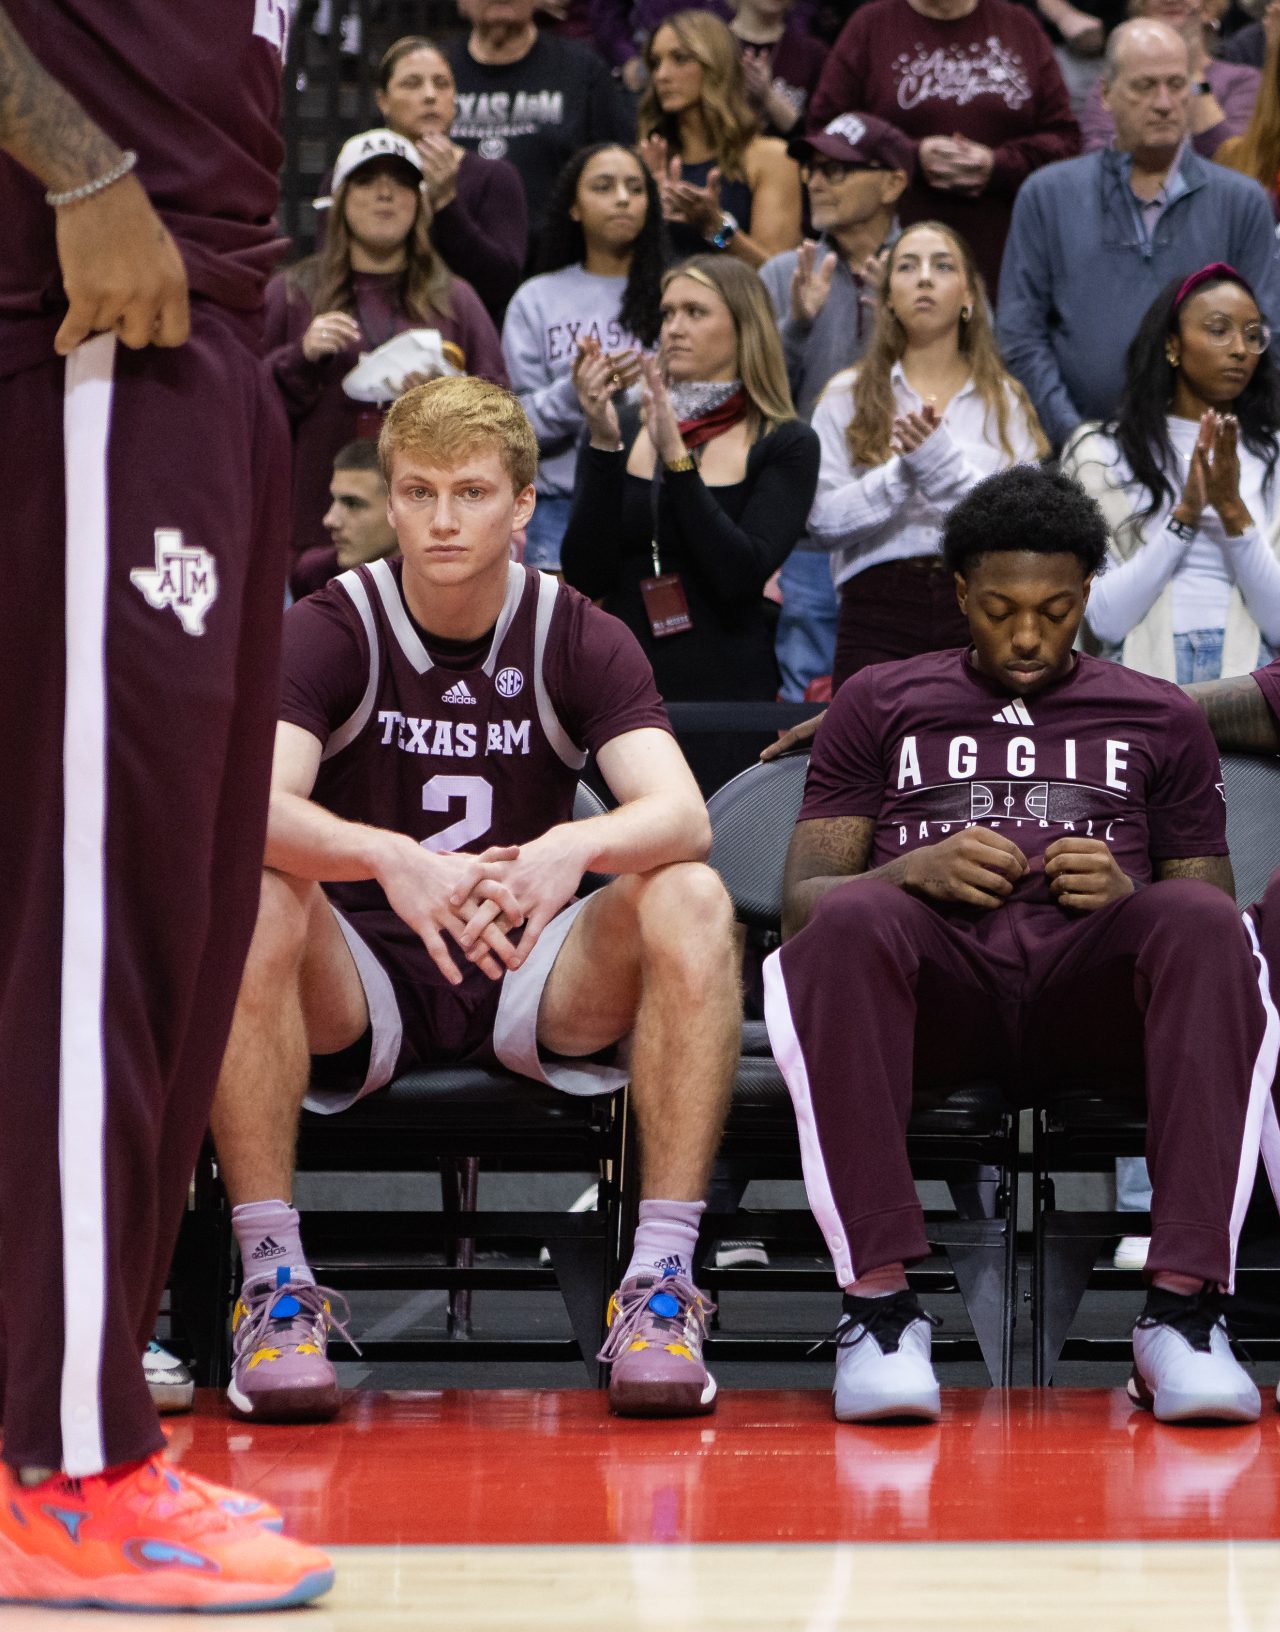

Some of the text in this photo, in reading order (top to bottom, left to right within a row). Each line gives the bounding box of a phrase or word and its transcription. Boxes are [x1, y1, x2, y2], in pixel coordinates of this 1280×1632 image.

[547, 320, 621, 361] EXAS
[441, 694, 477, 705] adidas
[498, 670, 521, 695] SEC
[484, 719, 531, 757] &M
[897, 735, 1130, 793] AGGIE
[419, 774, 493, 853] 2
[251, 1246, 287, 1260] adidas
